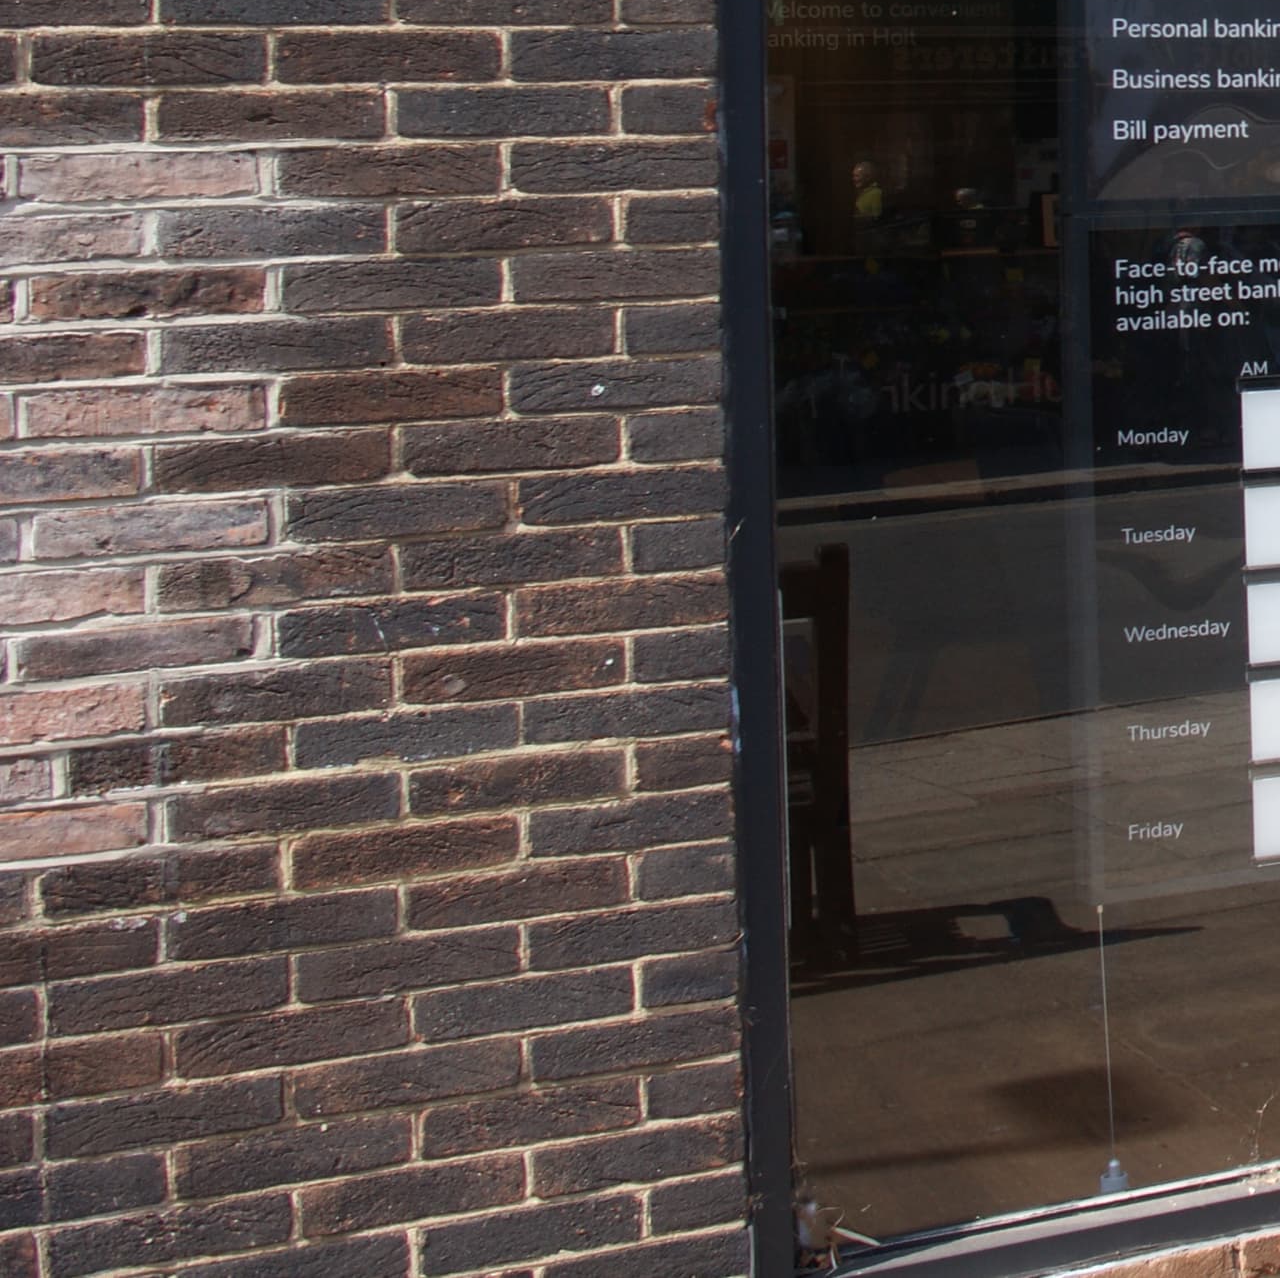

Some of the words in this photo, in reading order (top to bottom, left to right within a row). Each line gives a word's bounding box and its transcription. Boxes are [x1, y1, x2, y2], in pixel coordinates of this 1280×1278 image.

[767, 27, 839, 50] anking
[1112, 19, 1208, 39] Personal
[1112, 69, 1211, 90] Business
[1113, 120, 1147, 140] Bill
[1153, 121, 1249, 144] payment
[1115, 255, 1253, 280] Face-to-face
[1115, 281, 1164, 310] high
[1170, 279, 1232, 302] street
[1116, 308, 1212, 332] available
[1217, 310, 1250, 327] on:
[1240, 360, 1268, 376] AM
[1117, 426, 1189, 449] Monday
[1121, 524, 1196, 547] Tuesday
[1124, 619, 1230, 644] Wednesday
[1127, 719, 1211, 743] Thursday
[1127, 819, 1183, 842] Friday
